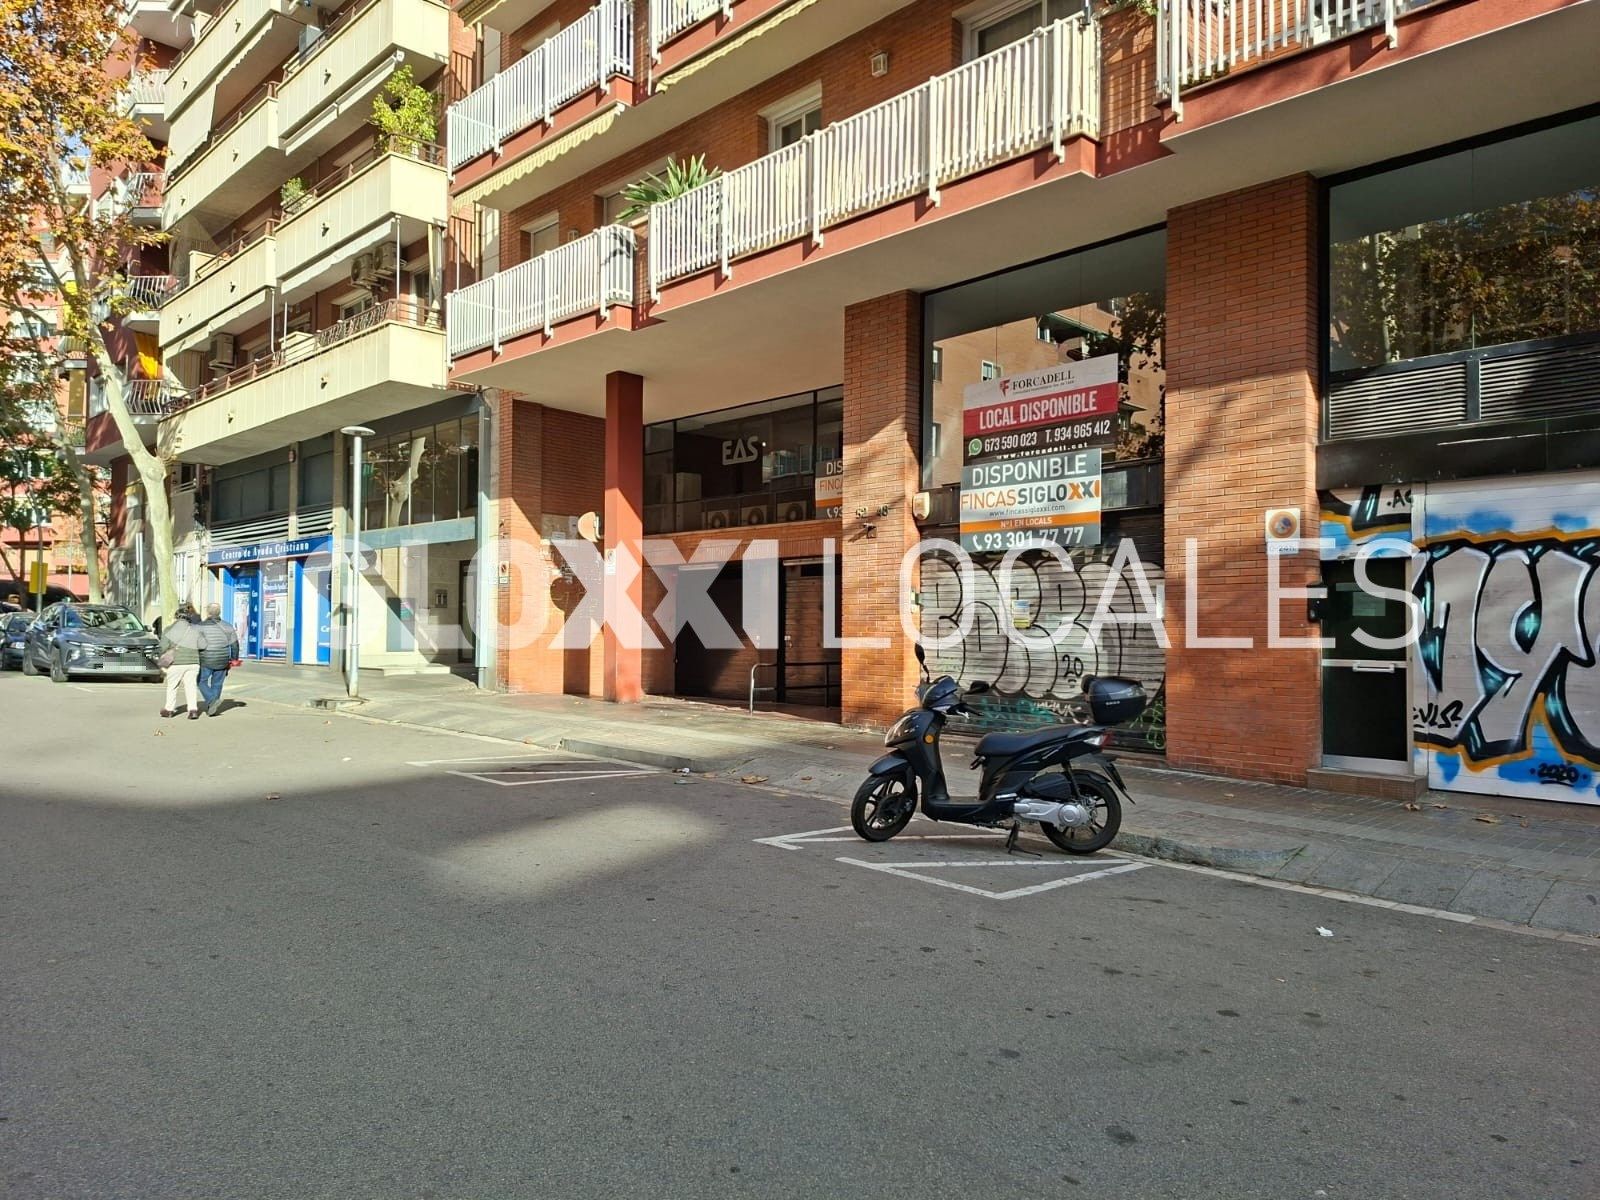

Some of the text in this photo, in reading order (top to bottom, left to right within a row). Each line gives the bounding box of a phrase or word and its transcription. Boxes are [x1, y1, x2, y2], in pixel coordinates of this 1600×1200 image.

[1012, 370, 1075, 391] FORCADELL
[979, 390, 1098, 431] LOCAL DISPONIBLE
[984, 438, 1000, 453] 673
[1001, 434, 1019, 449] 590
[1020, 432, 1038, 448] 023
[1054, 427, 1072, 442] 934
[1073, 423, 1093, 439] 965
[1094, 419, 1111, 436] 412
[721, 436, 760, 466] EAS
[972, 453, 1088, 487] DISPONIBLE
[1014, 518, 1025, 528] EN
[1025, 516, 1053, 527] LOCALS
[983, 526, 1085, 549] 93 301 77 77
[221, 541, 310, 561] Centro de Ayuda Cristiano
[1062, 653, 1084, 678] 20
